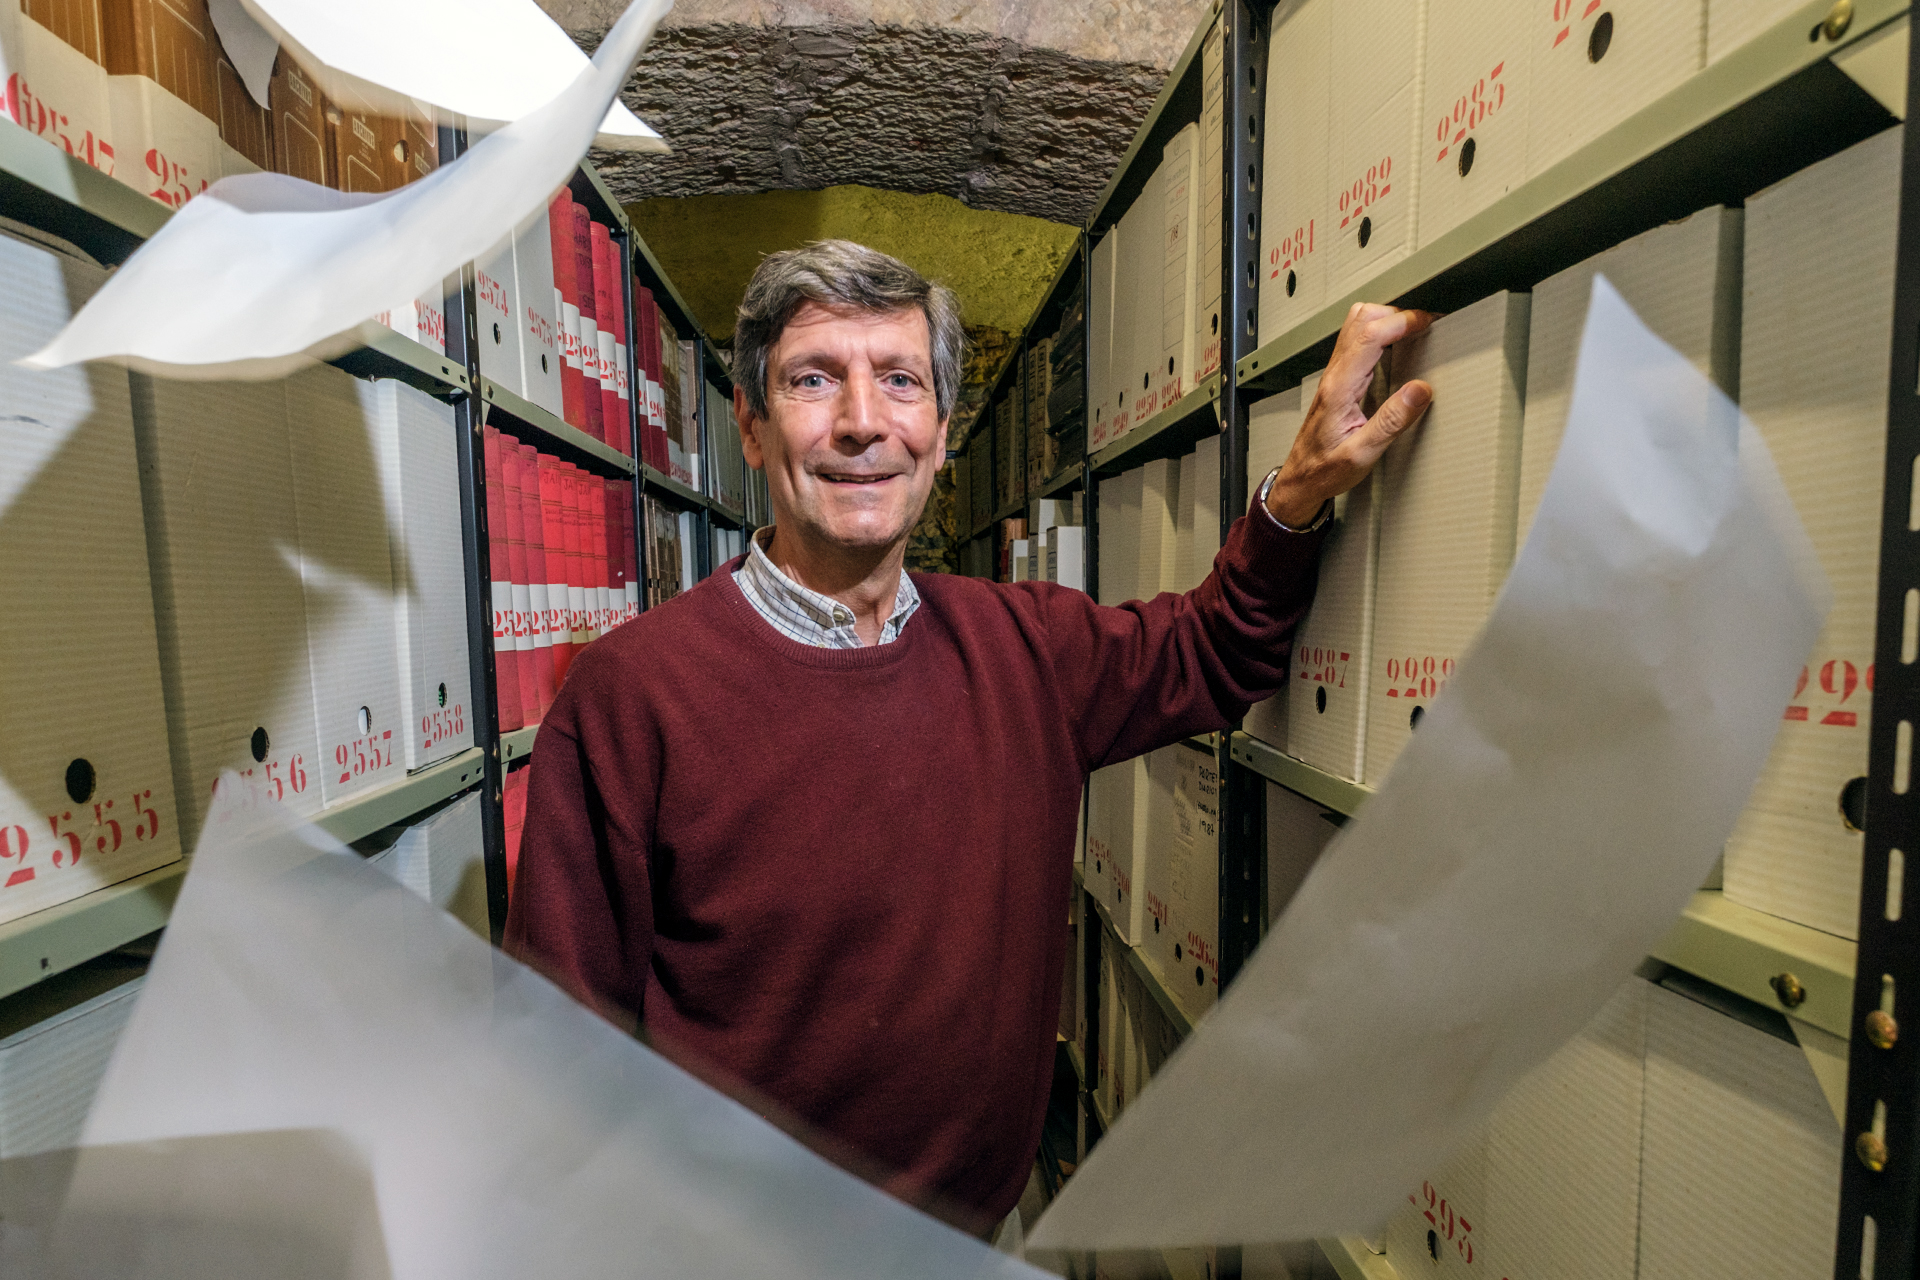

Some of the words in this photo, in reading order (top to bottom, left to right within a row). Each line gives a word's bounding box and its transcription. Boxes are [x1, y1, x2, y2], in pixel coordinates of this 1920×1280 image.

[1436, 61, 1505, 163] 2283
[1340, 156, 1392, 230] 2282
[1270, 219, 1315, 280] 2281
[478, 270, 508, 318] 2574
[528, 306, 553, 348] 2575
[1136, 391, 1158, 421] 2250
[1300, 646, 1350, 688] 2287
[422, 704, 464, 749] 2558
[335, 730, 393, 784] 2557
[0, 789, 159, 888] 2555
